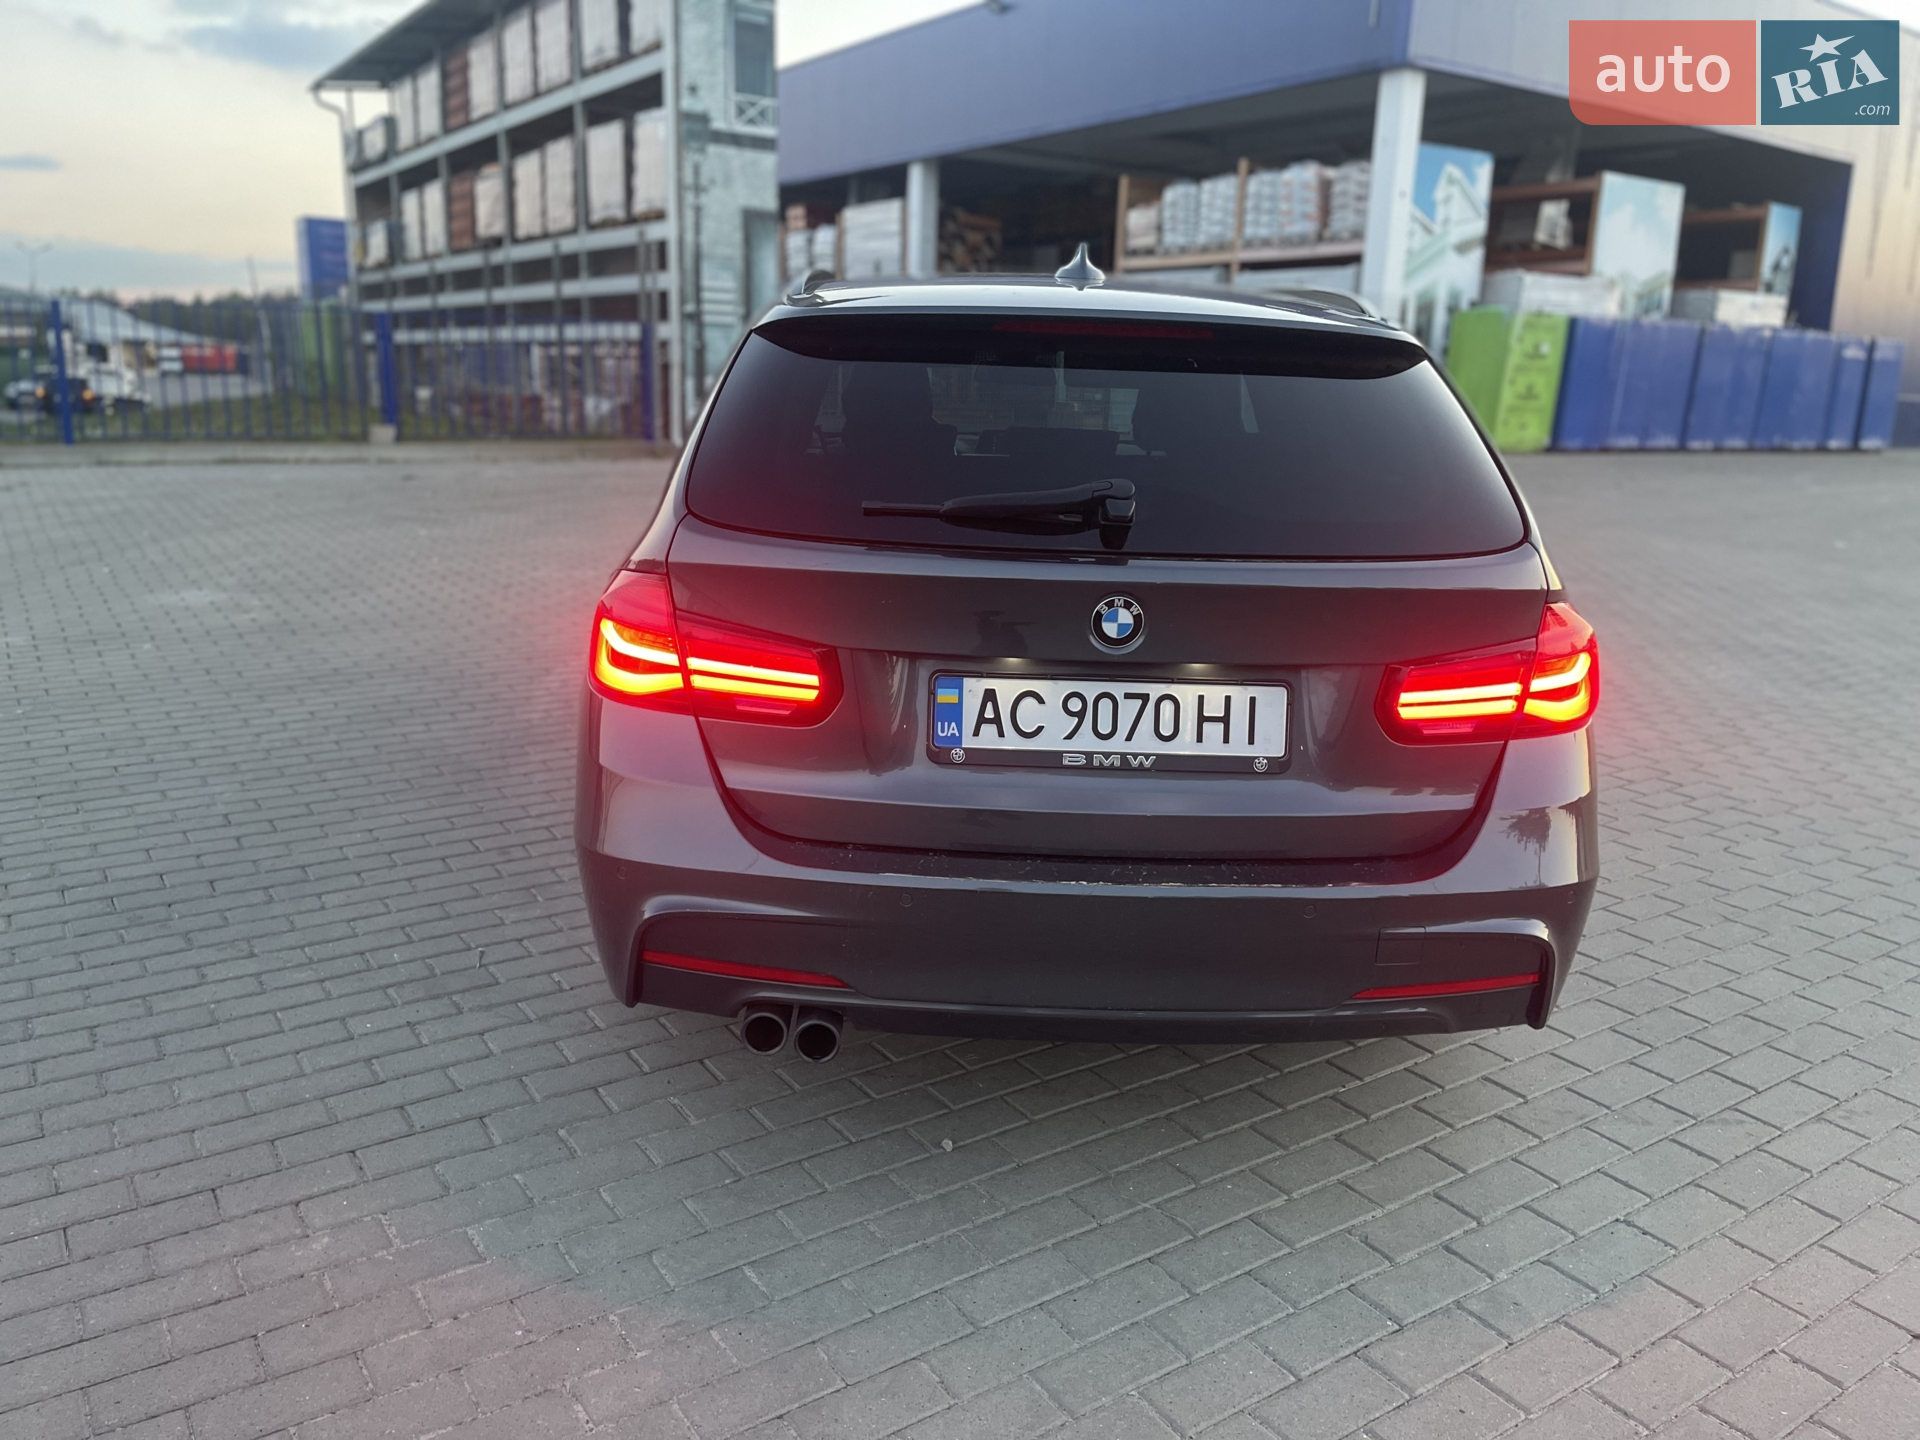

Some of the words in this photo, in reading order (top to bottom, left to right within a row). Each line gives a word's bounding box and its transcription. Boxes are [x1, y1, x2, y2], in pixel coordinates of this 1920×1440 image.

[1097, 598, 1141, 615] BMW
[972, 687, 1046, 739] AC
[1061, 691, 1181, 743] 9070
[1195, 694, 1257, 746] HI
[937, 721, 960, 737] UA
[1062, 753, 1156, 768] BMW
